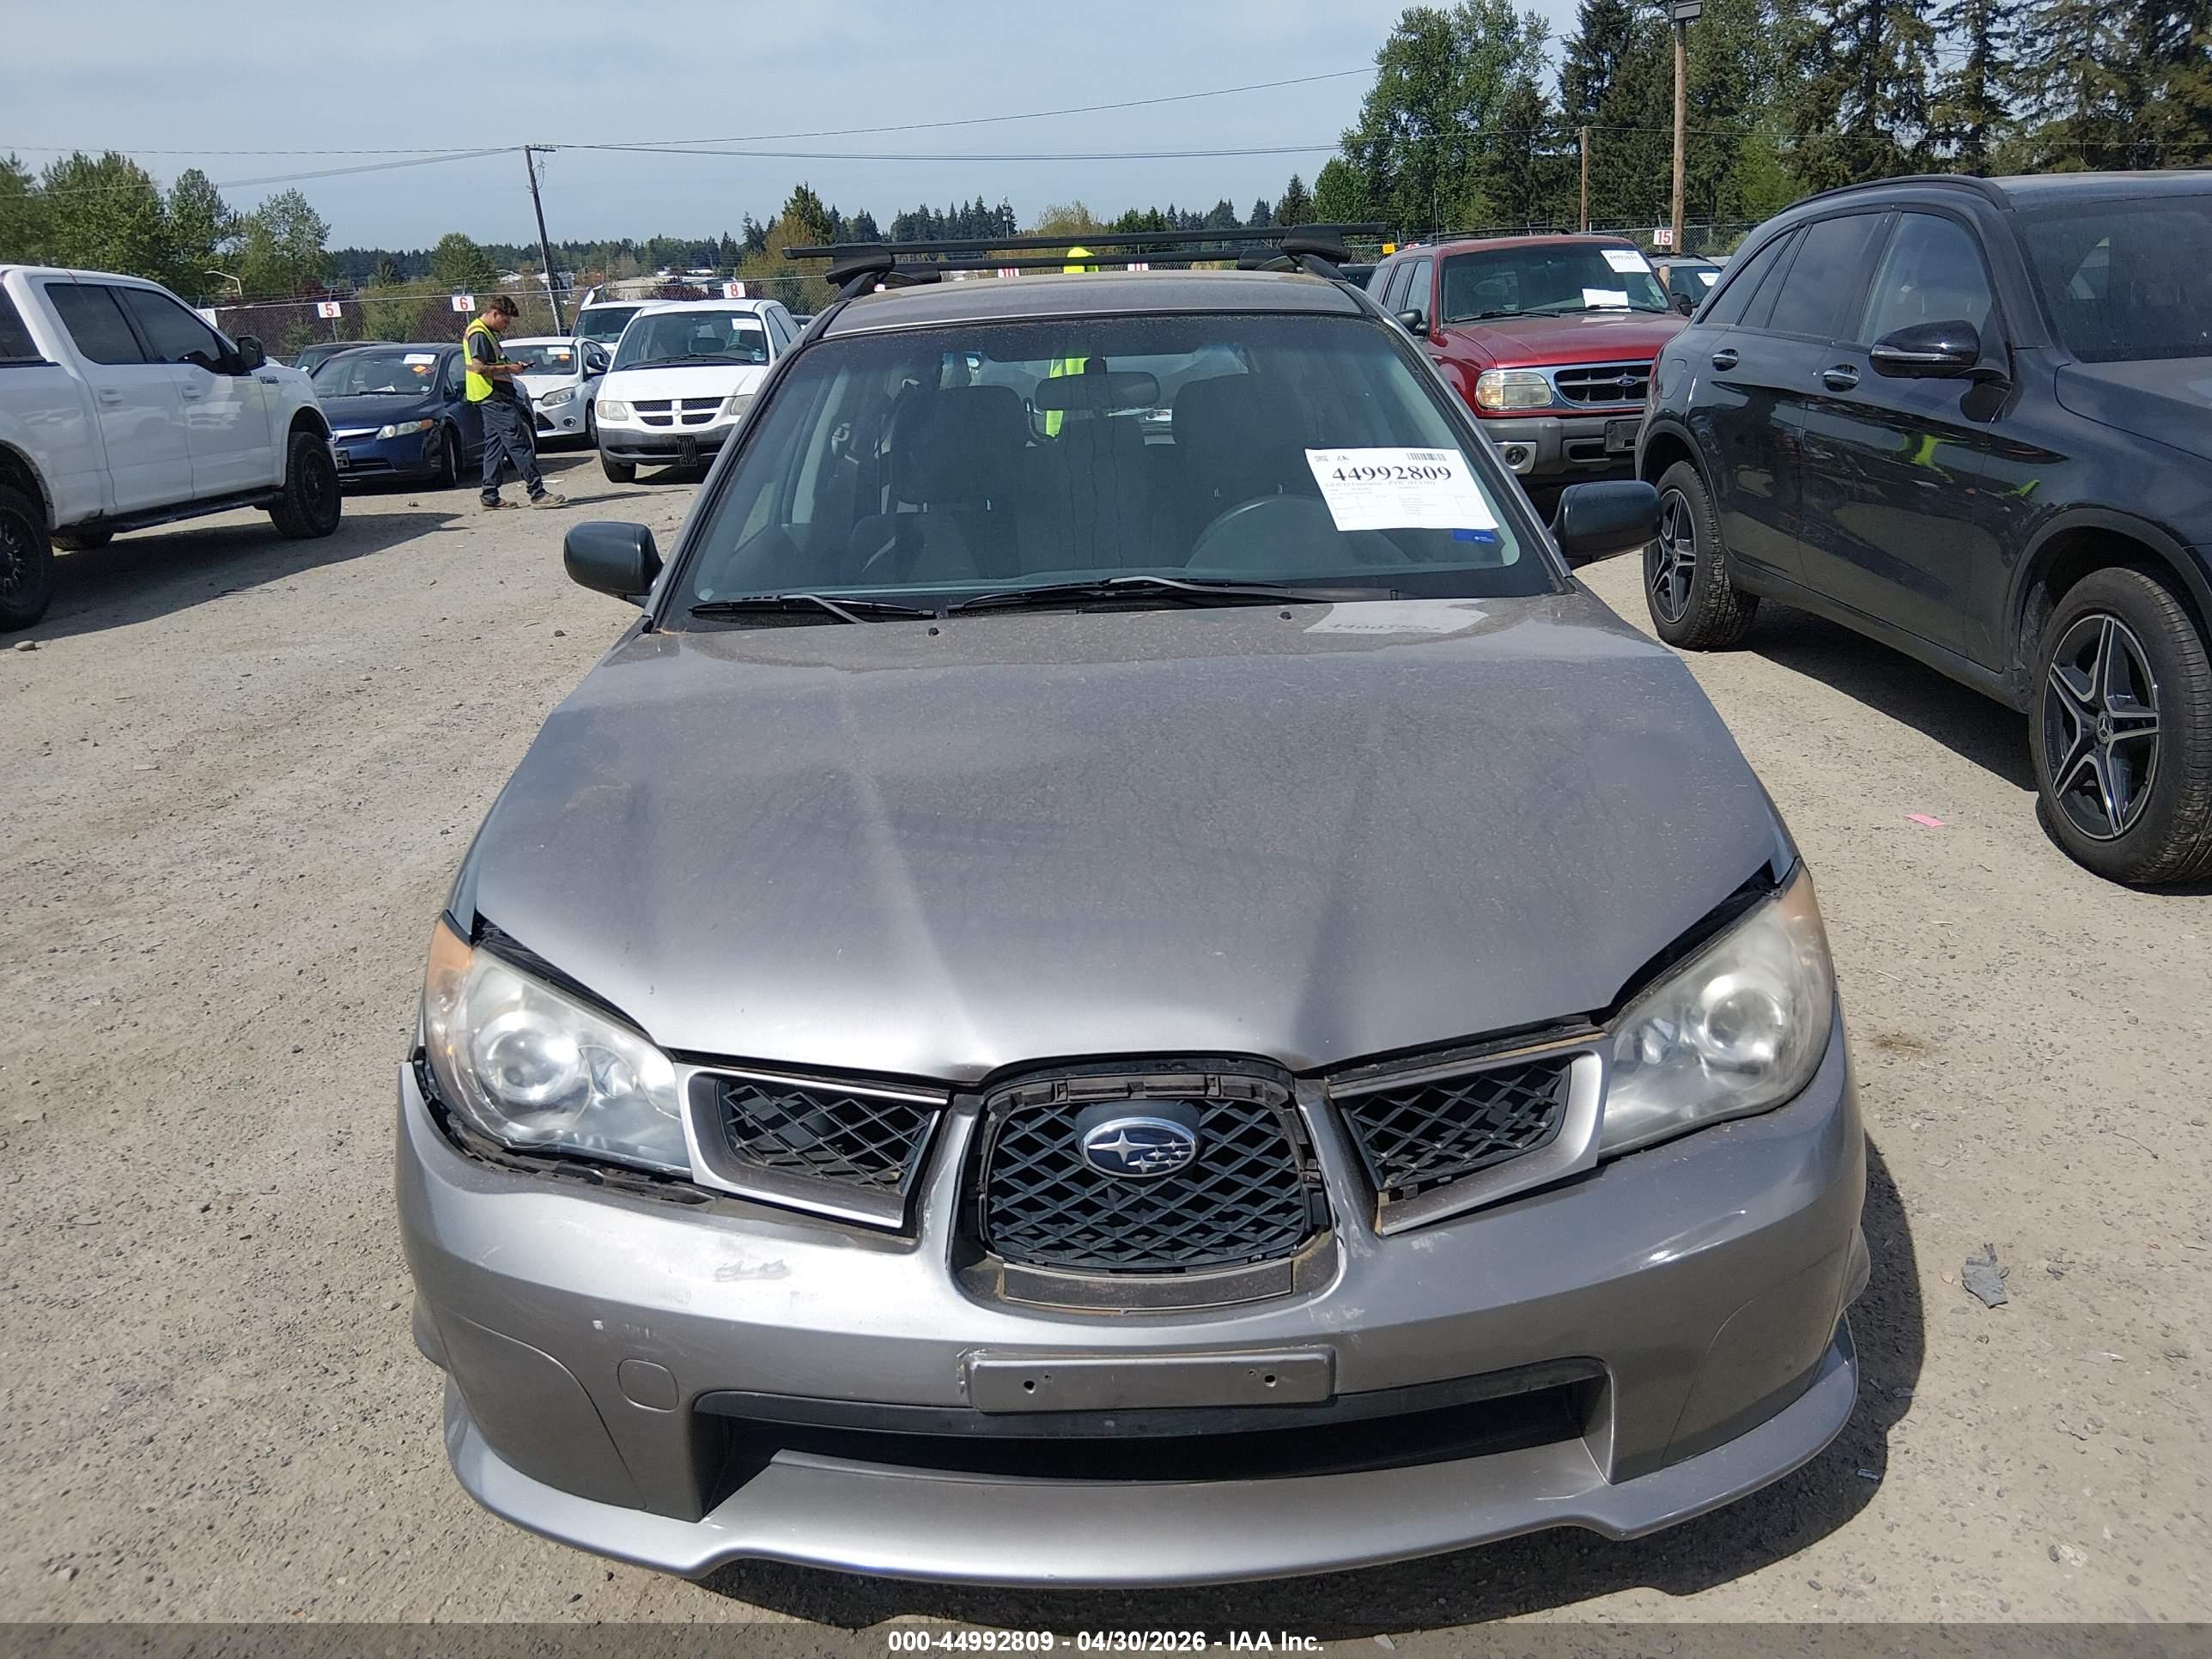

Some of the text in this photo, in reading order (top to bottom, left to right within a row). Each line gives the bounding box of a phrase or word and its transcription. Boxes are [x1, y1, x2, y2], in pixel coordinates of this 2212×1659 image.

[1658, 231, 1671, 244] 15
[730, 283, 738, 297] 8
[325, 303, 334, 317] 5
[459, 297, 468, 310] 6
[1332, 466, 1452, 481] 44992809
